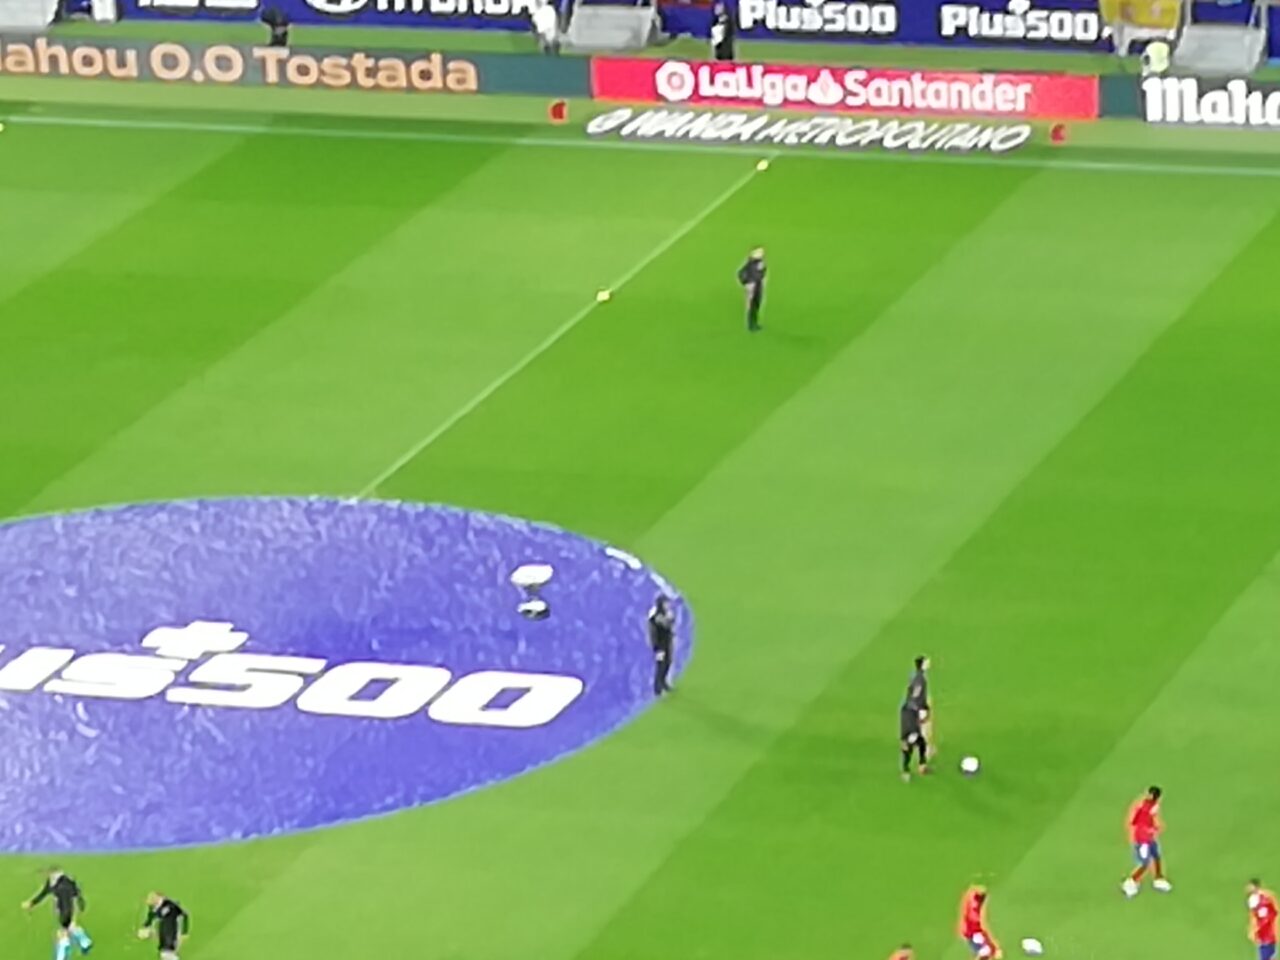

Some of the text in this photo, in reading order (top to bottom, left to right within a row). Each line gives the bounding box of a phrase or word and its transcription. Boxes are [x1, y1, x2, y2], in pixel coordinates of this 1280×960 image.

[739, 0, 897, 33] Plus500
[941, 4, 1099, 41] Plus500
[0, 37, 138, 78] ahou
[252, 46, 478, 92] Tostada
[698, 64, 1032, 112] LaLiga Santander
